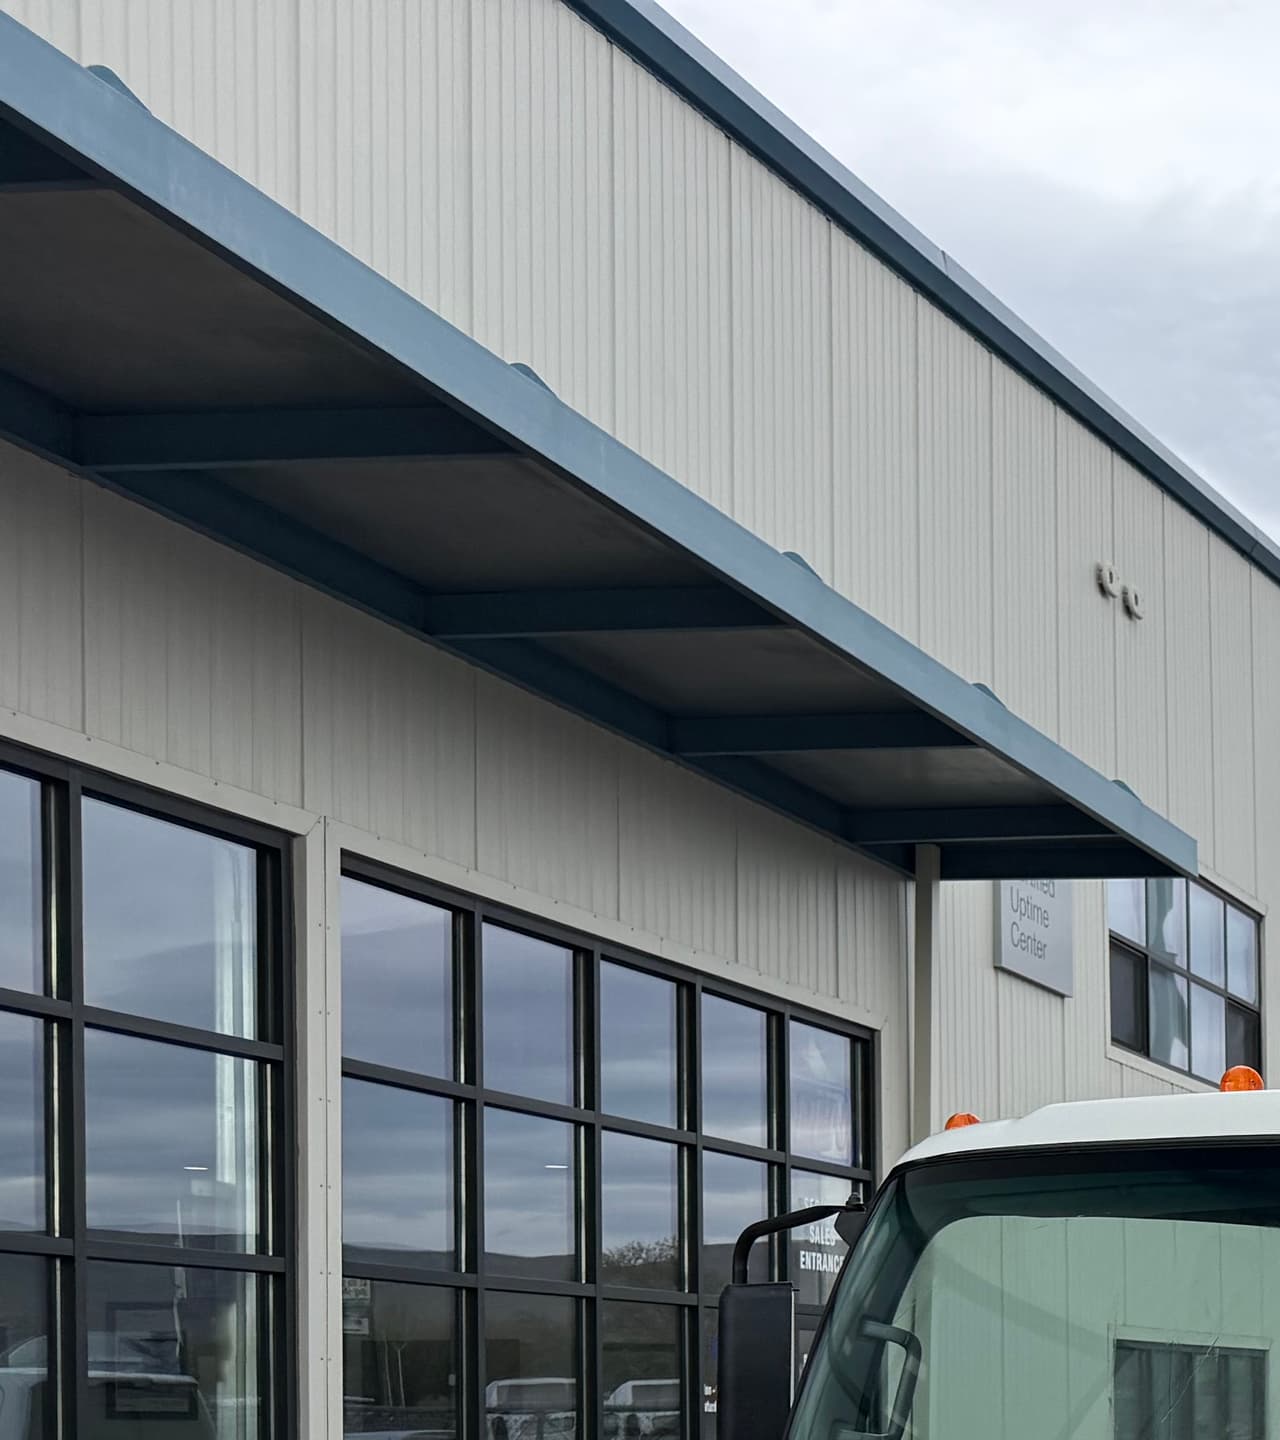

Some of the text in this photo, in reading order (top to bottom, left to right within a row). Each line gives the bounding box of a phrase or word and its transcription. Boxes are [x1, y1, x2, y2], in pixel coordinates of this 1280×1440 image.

[1010, 886, 1049, 928] Uptime
[1010, 921, 1047, 960] Center
[809, 1225, 836, 1246] SALES
